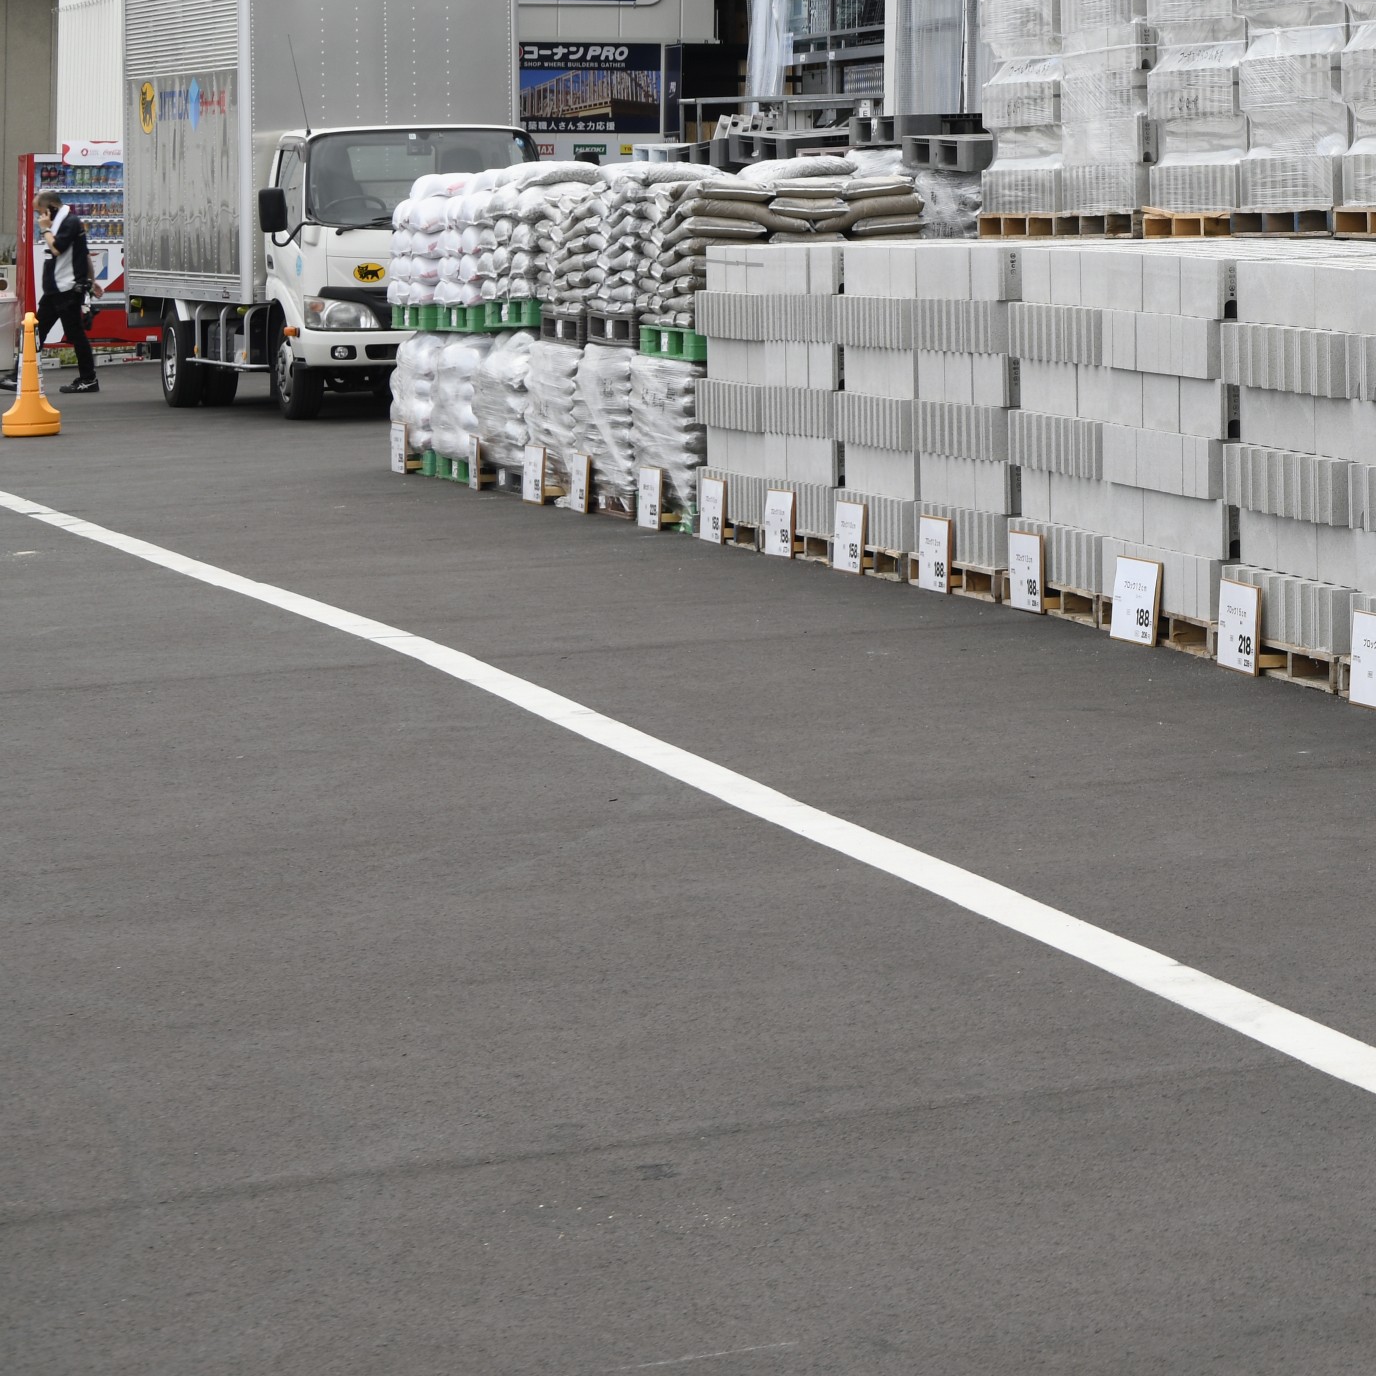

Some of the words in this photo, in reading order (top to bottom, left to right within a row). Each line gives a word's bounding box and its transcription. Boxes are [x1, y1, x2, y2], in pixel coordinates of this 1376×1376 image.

[524, 45, 584, 60] コーナン
[586, 46, 629, 60] PRO
